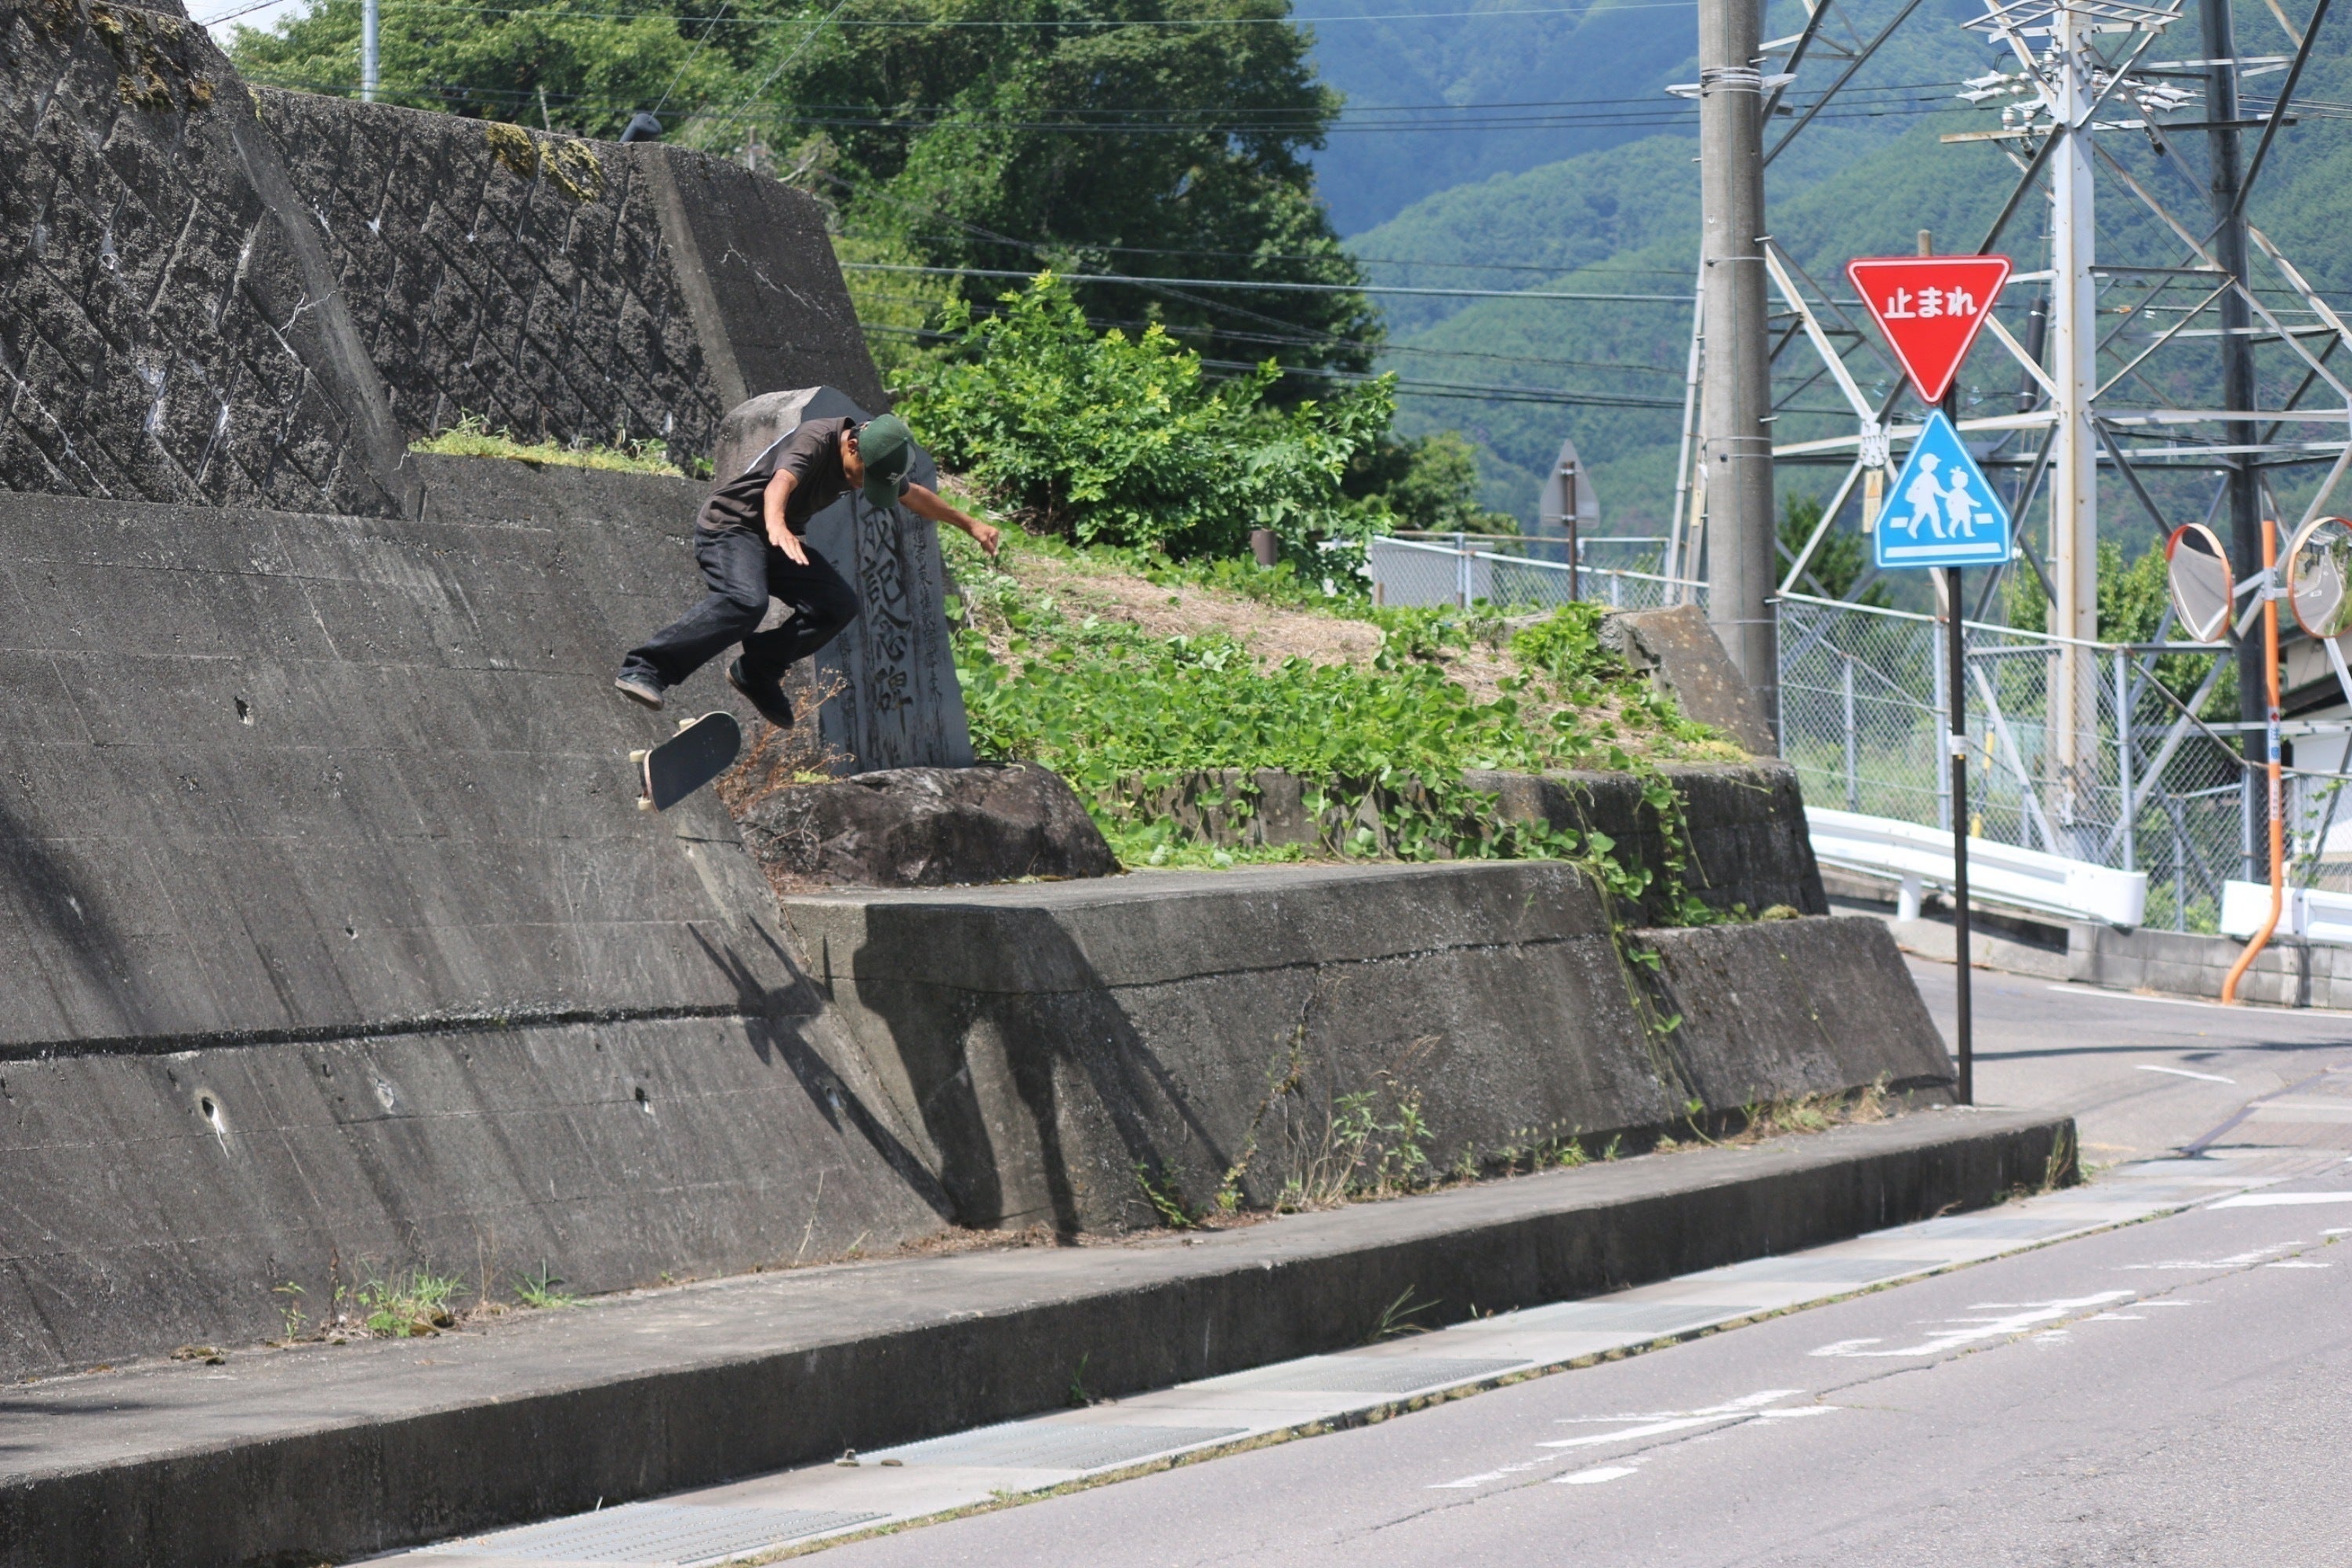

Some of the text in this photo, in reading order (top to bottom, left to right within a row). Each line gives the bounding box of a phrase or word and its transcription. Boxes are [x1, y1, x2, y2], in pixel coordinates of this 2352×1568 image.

[1883, 286, 1978, 319] 止まれ
[859, 491, 913, 735] 成記念碑
[2270, 727, 2281, 760] 注意
